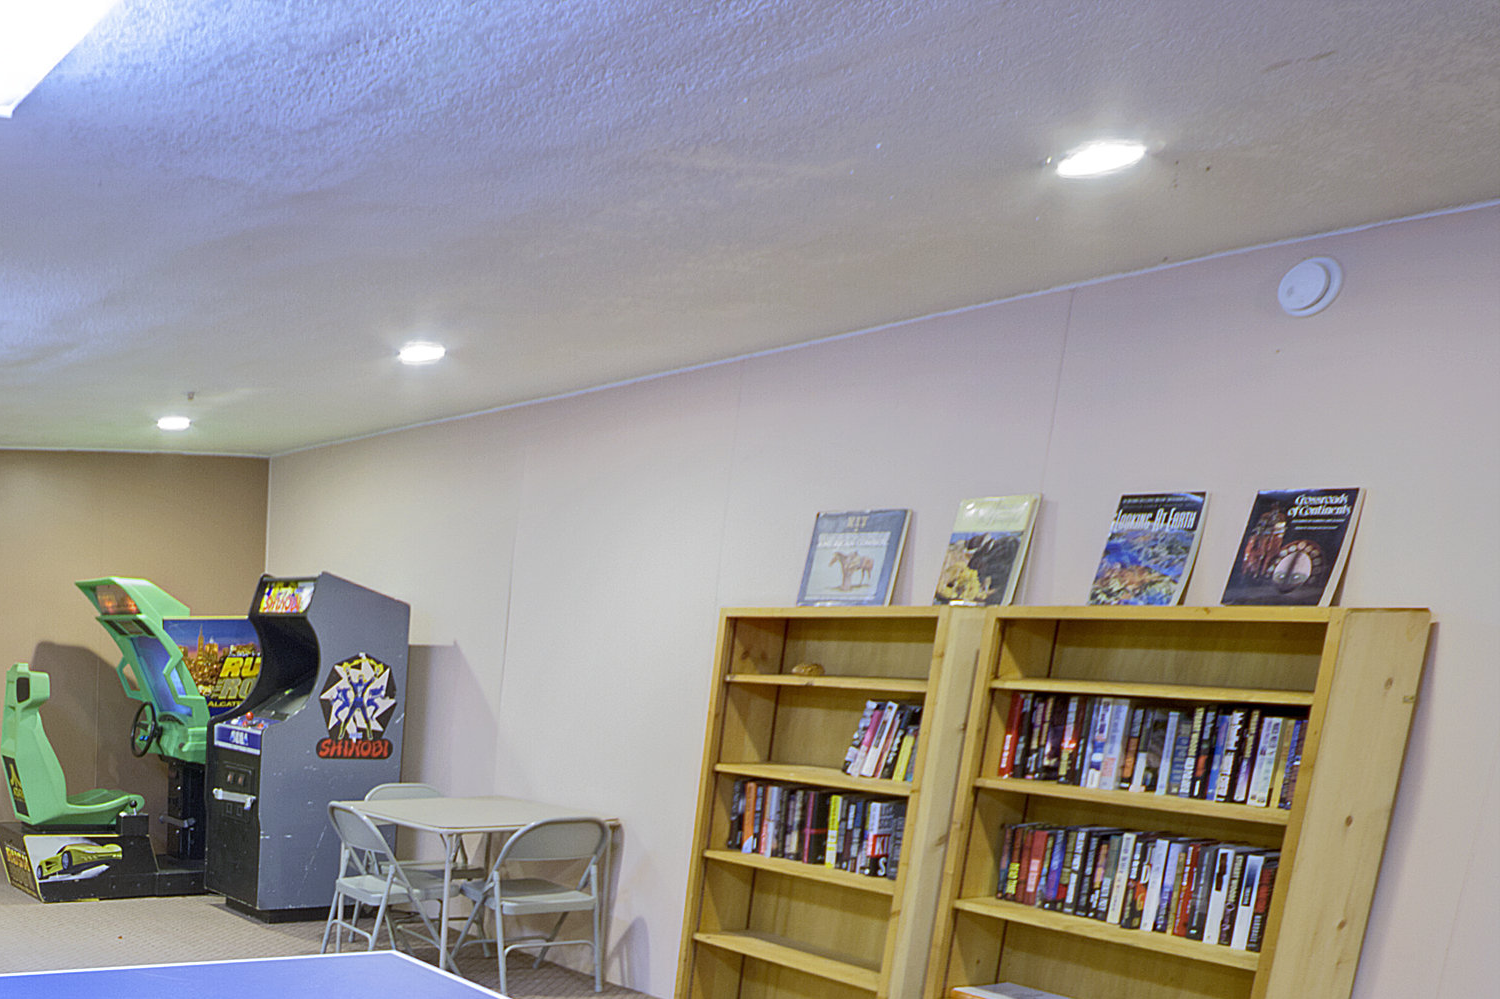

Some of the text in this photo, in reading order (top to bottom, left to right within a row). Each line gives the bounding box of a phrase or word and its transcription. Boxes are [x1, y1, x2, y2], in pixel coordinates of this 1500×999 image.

[1294, 493, 1349, 506] Crossroads
[1287, 504, 1353, 518] of Continents
[220, 656, 261, 678] RU
[219, 678, 257, 700] RO
[318, 739, 389, 757] SHINOBI
